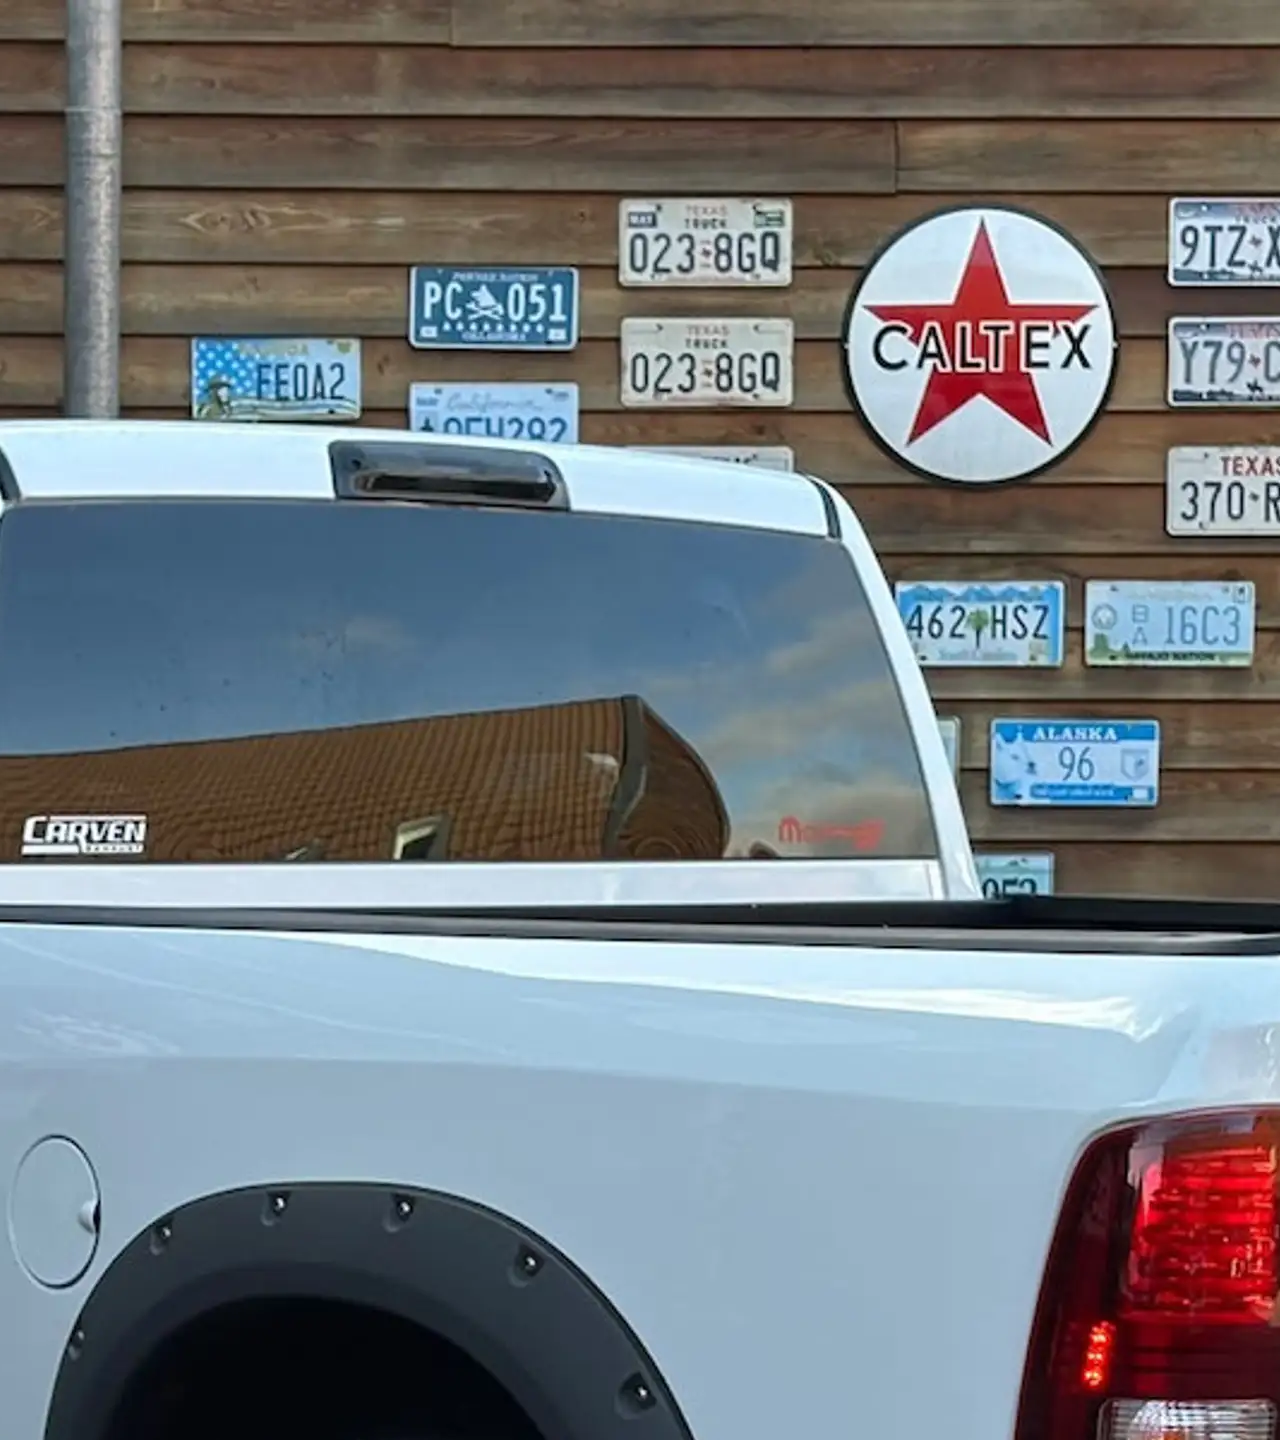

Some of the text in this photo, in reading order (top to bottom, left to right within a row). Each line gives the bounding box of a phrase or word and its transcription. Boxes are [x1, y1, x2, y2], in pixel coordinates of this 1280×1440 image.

[685, 205, 728, 215] TEXAS
[684, 218, 727, 229] TRUCK
[423, 281, 567, 322] PC 051
[686, 325, 730, 336] TEXAS
[685, 338, 728, 349] TRUCK
[872, 322, 1093, 371] CALTEX
[906, 605, 1049, 639] 462 HSZ
[1033, 726, 1118, 741] ALASKA
[1057, 746, 1095, 781] 96
[23, 815, 147, 850] CARVEN
